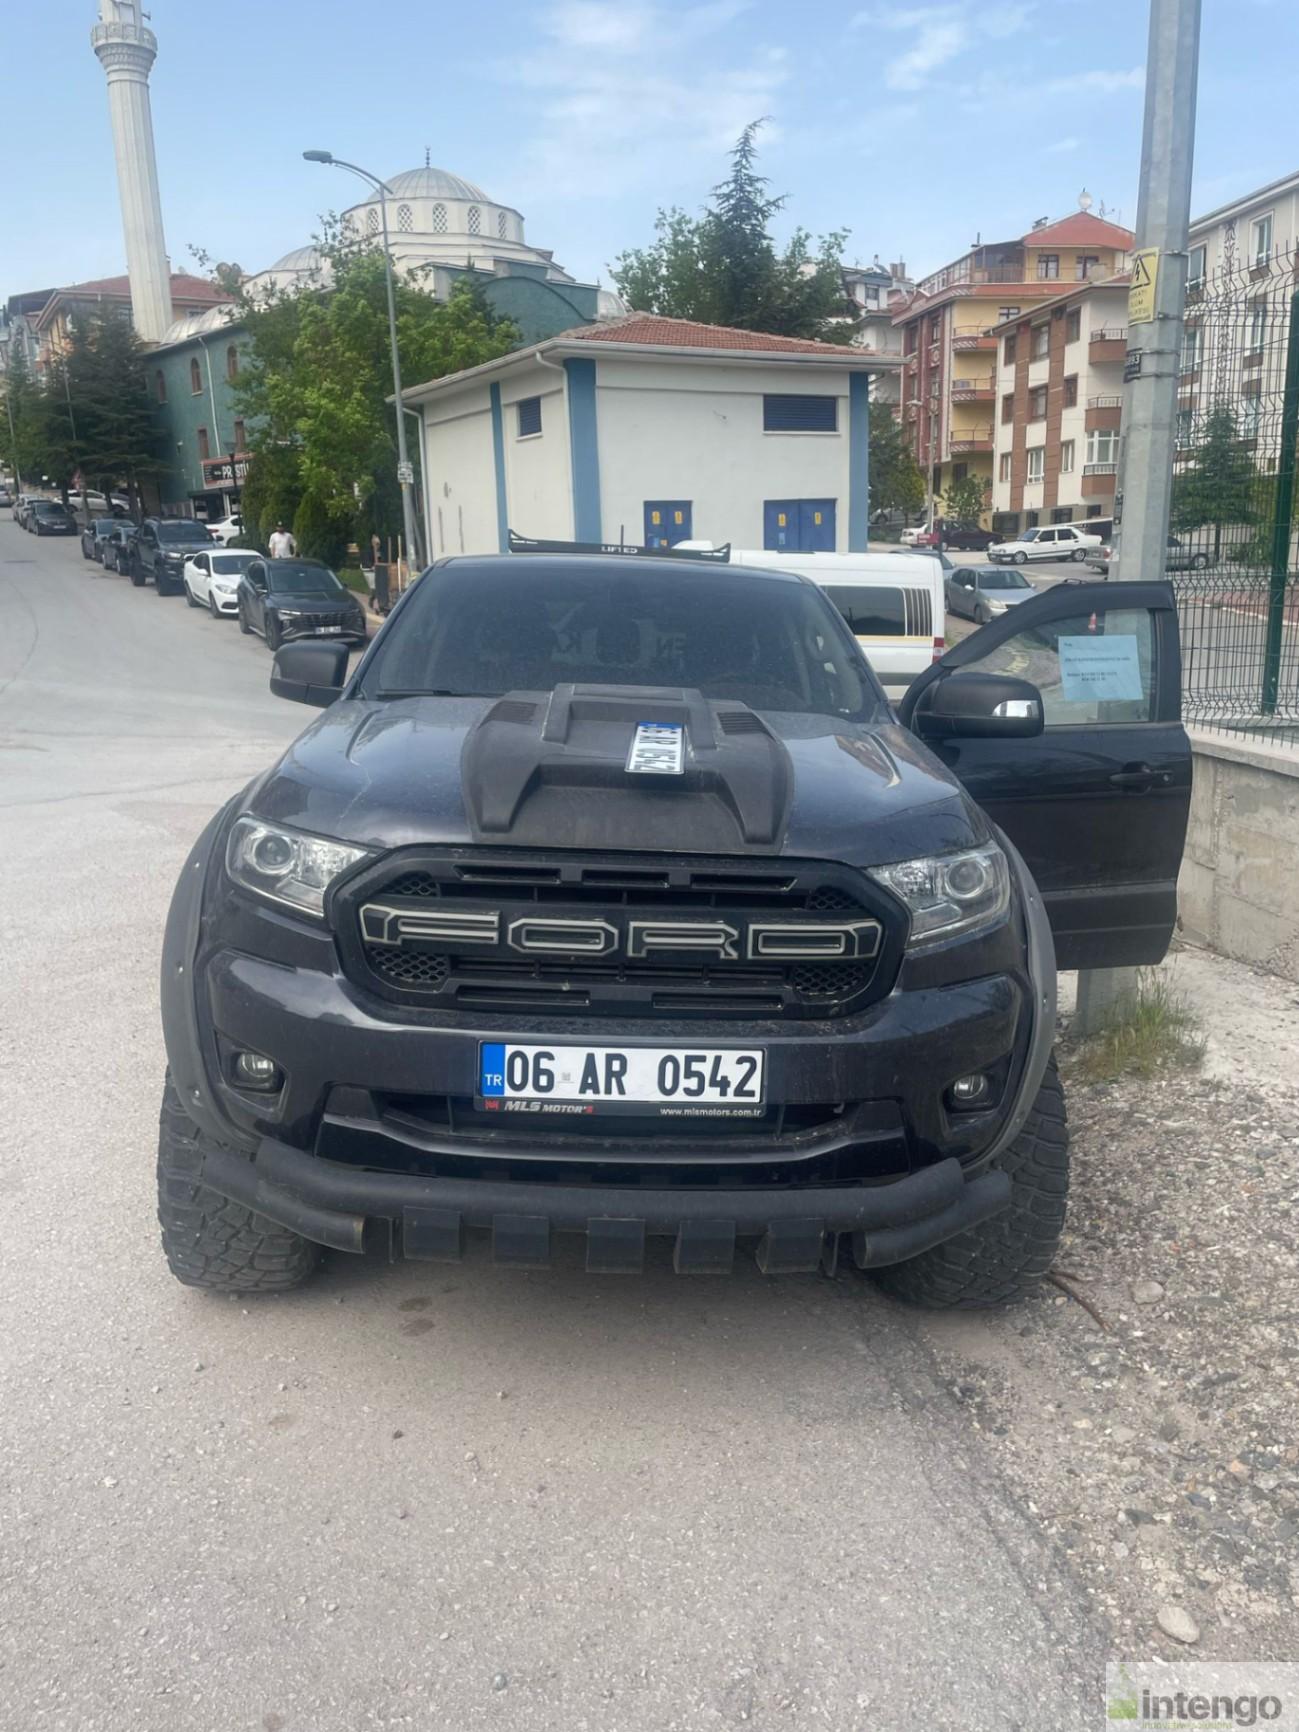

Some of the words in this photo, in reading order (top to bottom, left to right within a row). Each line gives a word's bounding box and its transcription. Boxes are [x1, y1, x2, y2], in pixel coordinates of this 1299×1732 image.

[359, 904, 882, 960] FORD
[506, 1049, 555, 1093] 06
[578, 1052, 628, 1096] AR
[657, 1054, 758, 1098] 0542
[484, 1074, 502, 1086] TR
[504, 1100, 542, 1112] MLS
[660, 1106, 762, 1117] www.mlsmotors.com.tr
